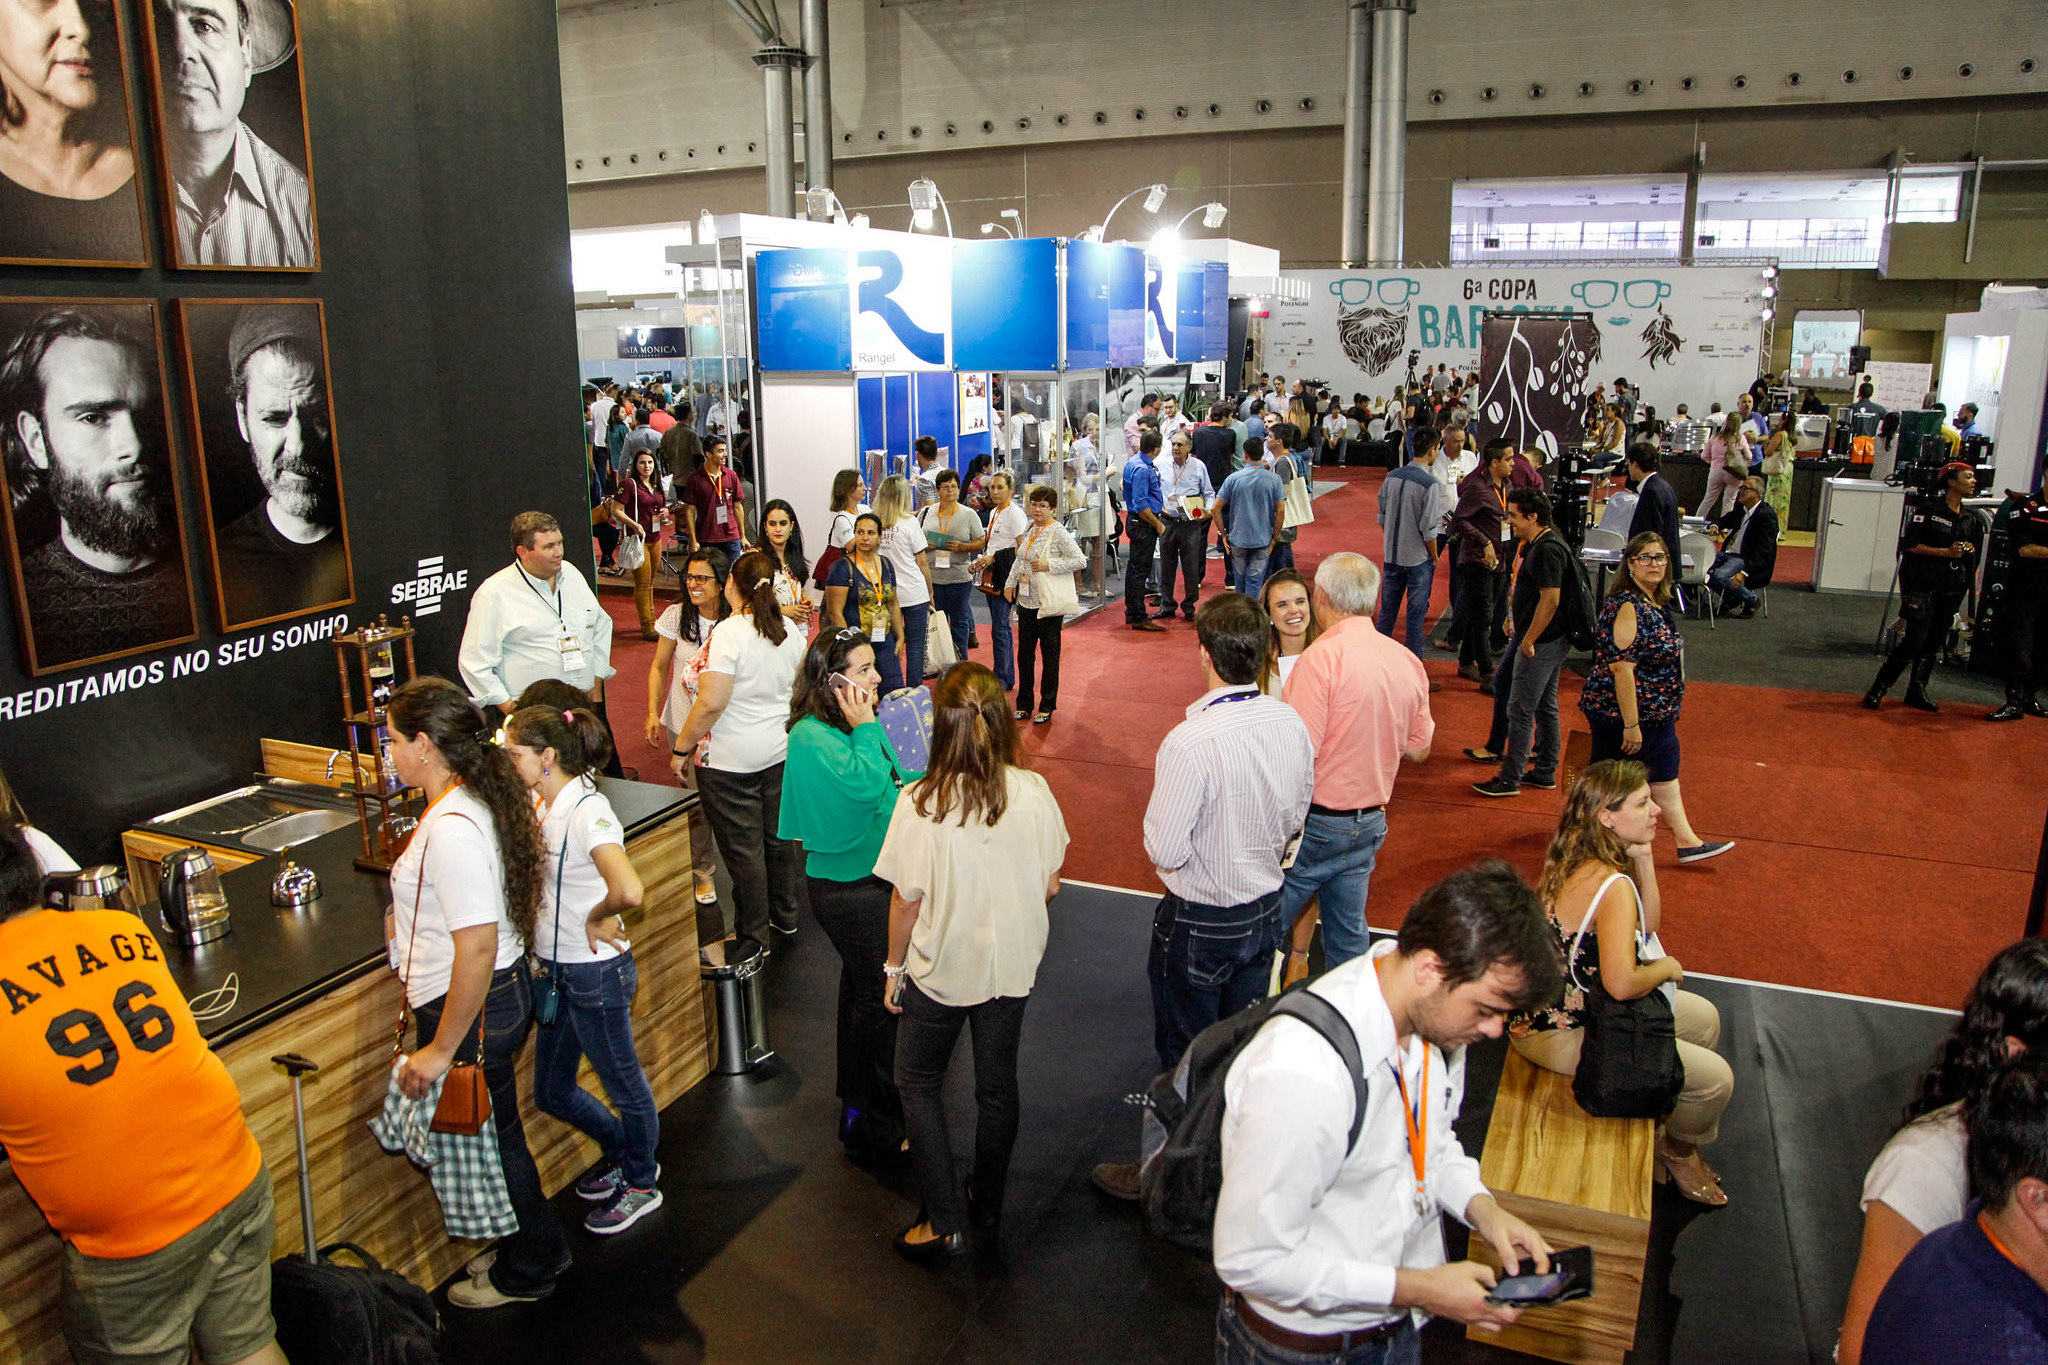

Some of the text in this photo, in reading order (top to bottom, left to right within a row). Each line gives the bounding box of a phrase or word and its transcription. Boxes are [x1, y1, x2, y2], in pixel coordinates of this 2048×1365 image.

[1489, 278, 1538, 300] COPA
[858, 353, 896, 365] Rangel
[391, 569, 468, 604] SEBRAE
[172, 649, 210, 679] NO
[217, 635, 265, 666] SEU
[271, 613, 349, 652] SONHO
[45, 980, 175, 1086] 96
